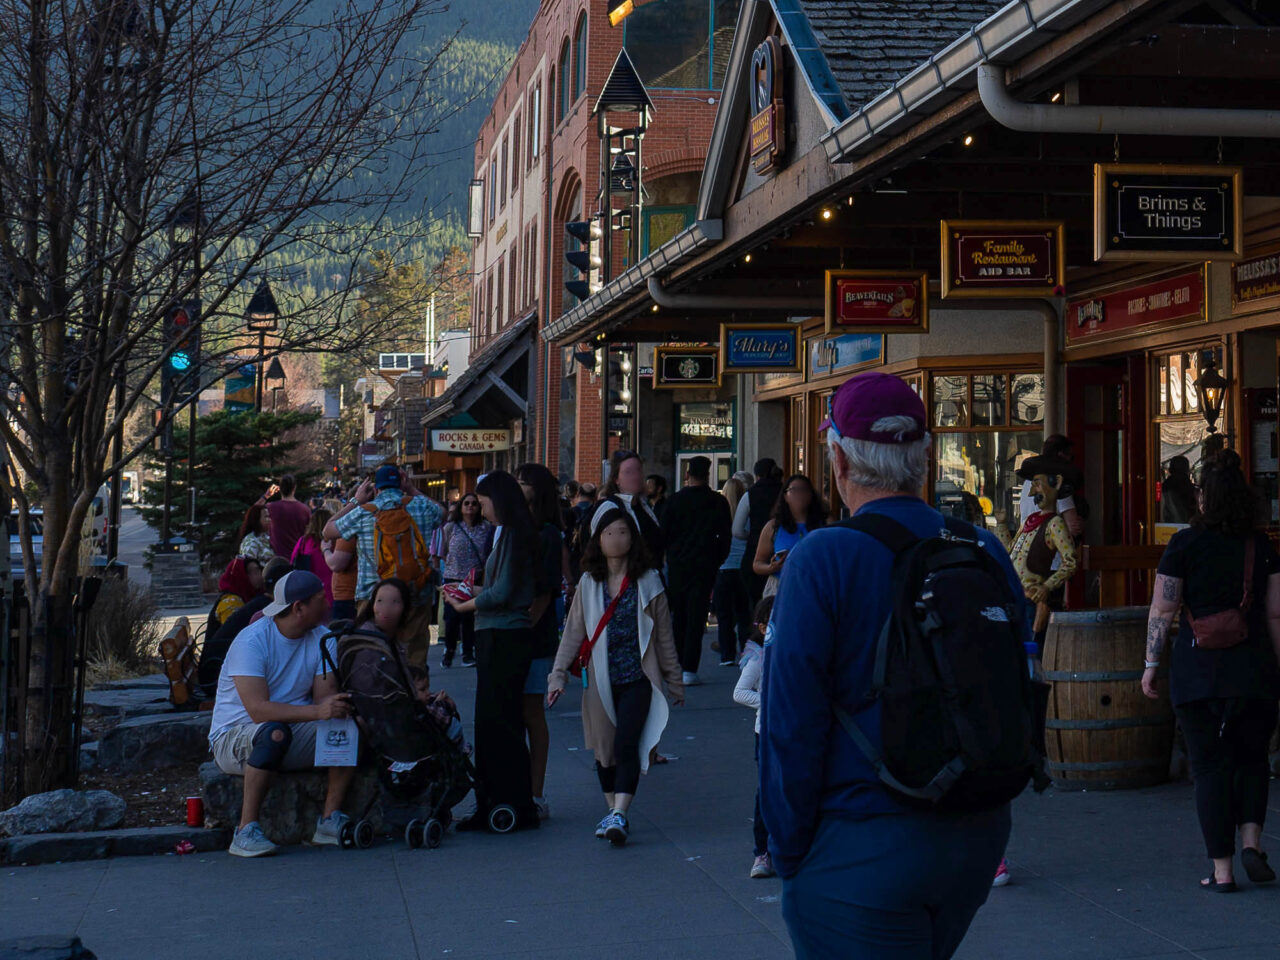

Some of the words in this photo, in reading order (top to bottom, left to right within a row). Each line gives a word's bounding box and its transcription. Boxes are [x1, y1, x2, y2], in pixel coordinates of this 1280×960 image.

[1138, 194, 1189, 211] Brims
[1192, 196, 1207, 211] &
[1143, 211, 1202, 231] Things
[983, 240, 1025, 255] Family
[971, 251, 1038, 265] Restaurant
[978, 266, 1003, 276] AND
[1006, 266, 1031, 276] BAR
[1237, 256, 1278, 283] MELISSA'S
[733, 336, 790, 359] Mary's
[710, 416, 733, 425] EDWA
[438, 432, 469, 442] ROCKS
[471, 432, 479, 442] &
[482, 432, 506, 442] GEMS
[458, 442, 485, 450] CANADA
